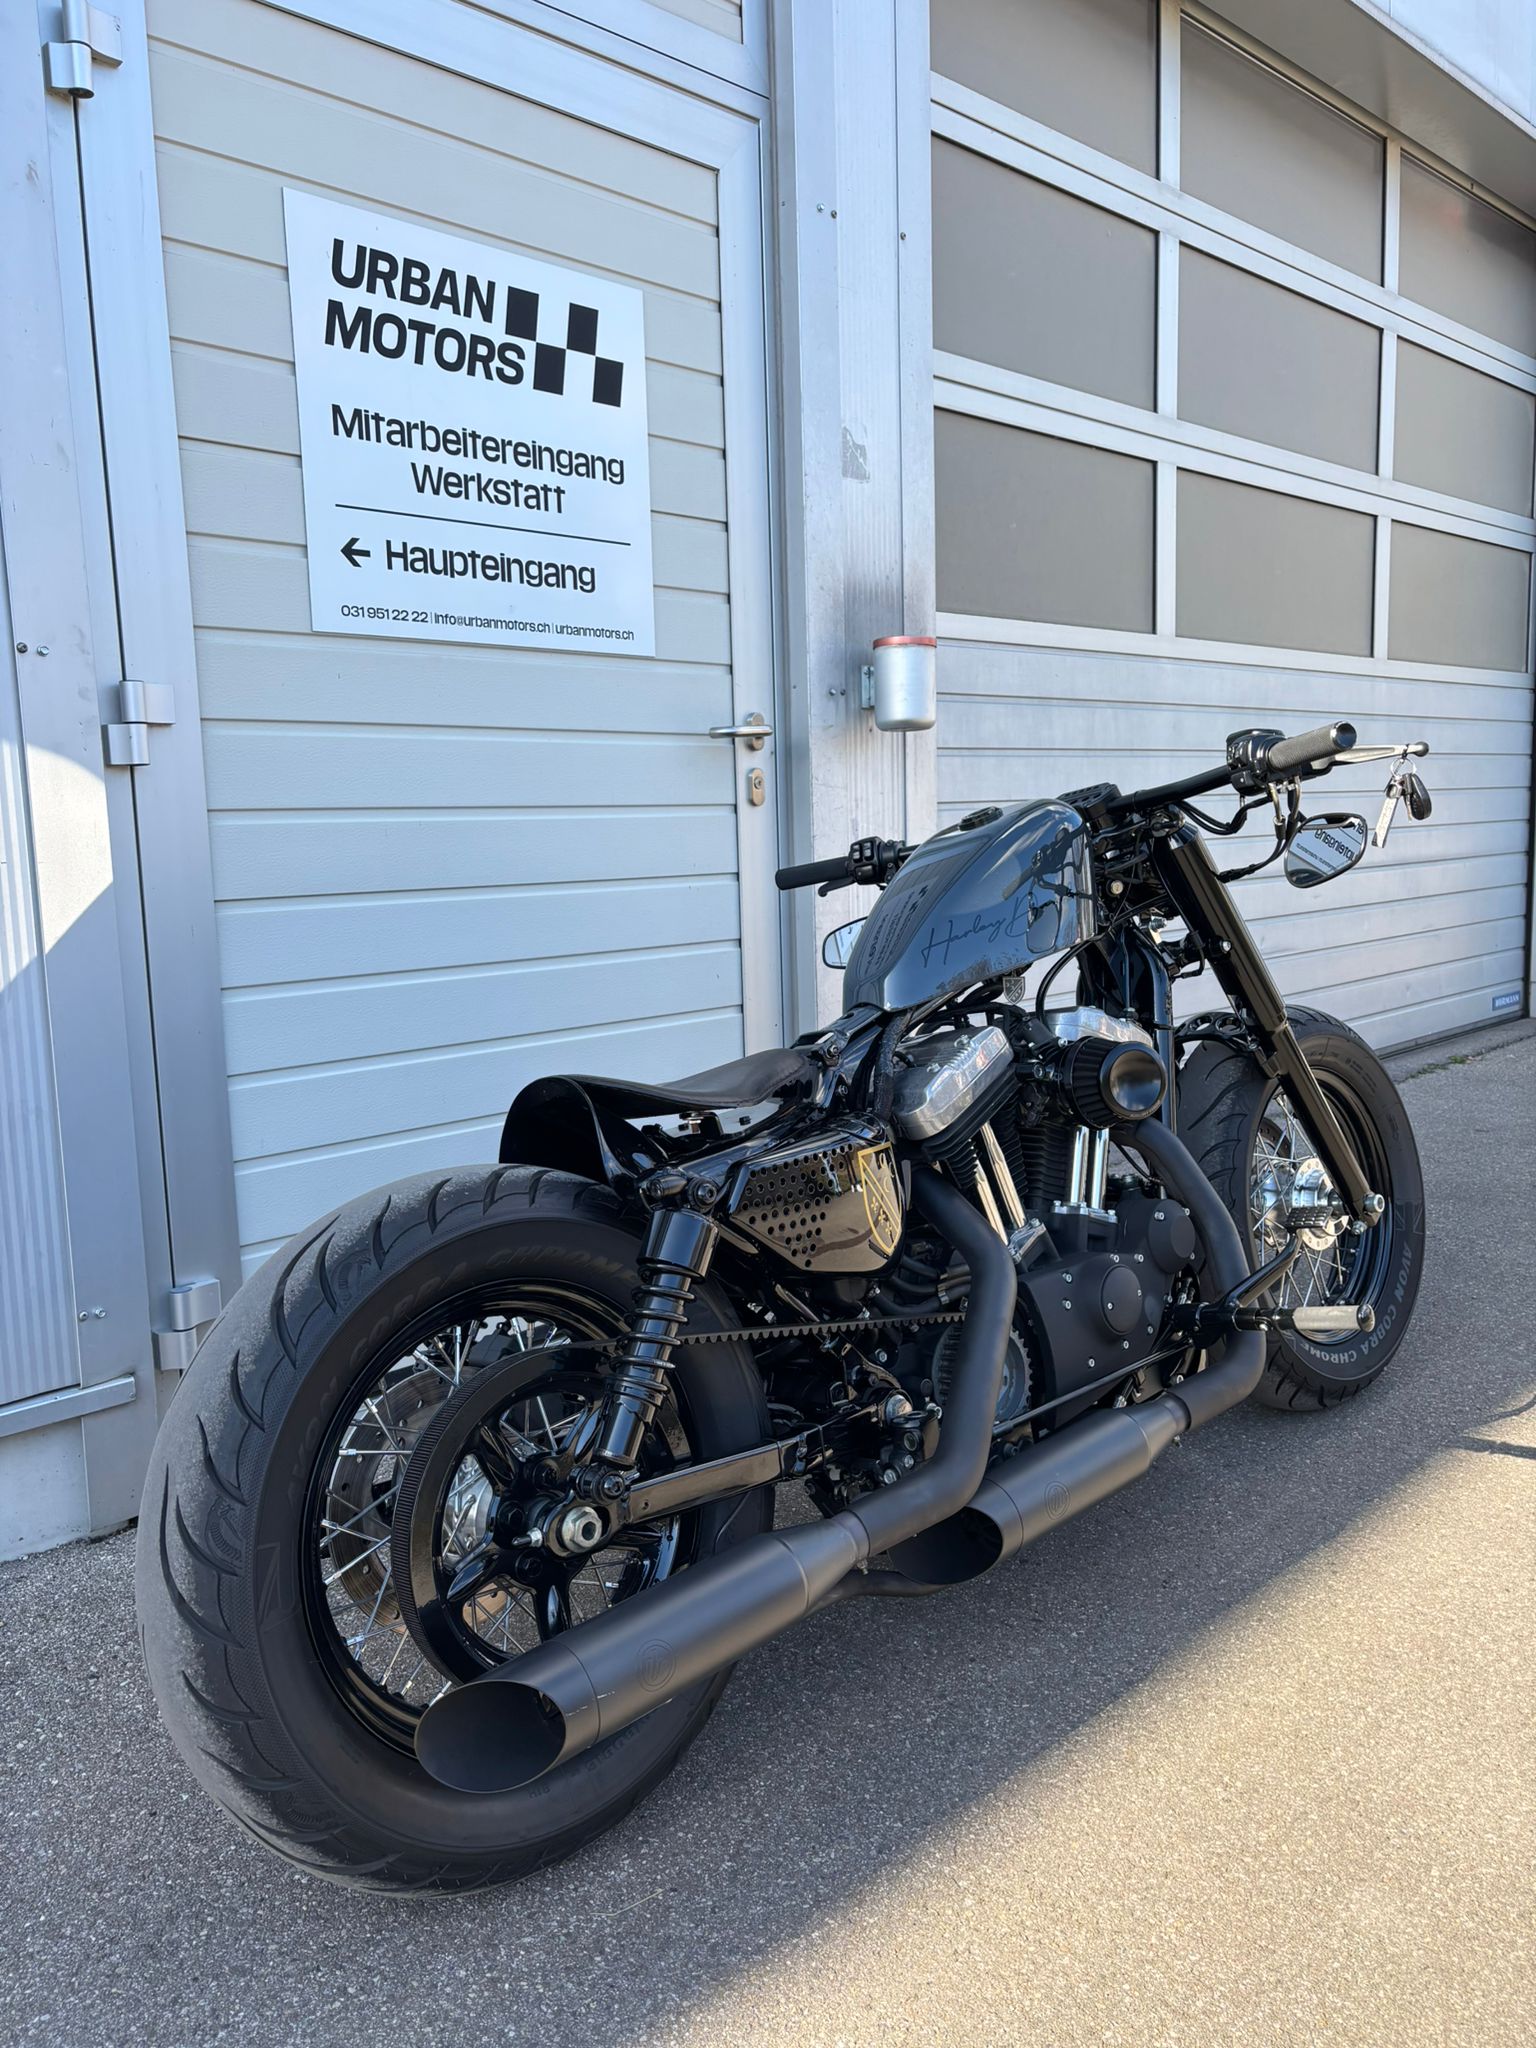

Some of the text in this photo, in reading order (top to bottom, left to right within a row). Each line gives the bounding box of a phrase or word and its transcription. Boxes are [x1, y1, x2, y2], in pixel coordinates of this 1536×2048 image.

[331, 237, 496, 324] URBAN
[324, 298, 527, 386] MOTORS
[331, 403, 625, 485] Mitarbeitereingang
[410, 461, 566, 514] Werkstatt
[385, 539, 596, 594] Haupteingang
[340, 604, 365, 618] 031
[366, 606, 390, 620] 951
[391, 608, 410, 622] 22
[411, 610, 429, 624] 22
[555, 624, 635, 641] urbanmotors.ch
[1393, 1241, 1412, 1303] AVON
[1360, 1304, 1397, 1355] COBRA
